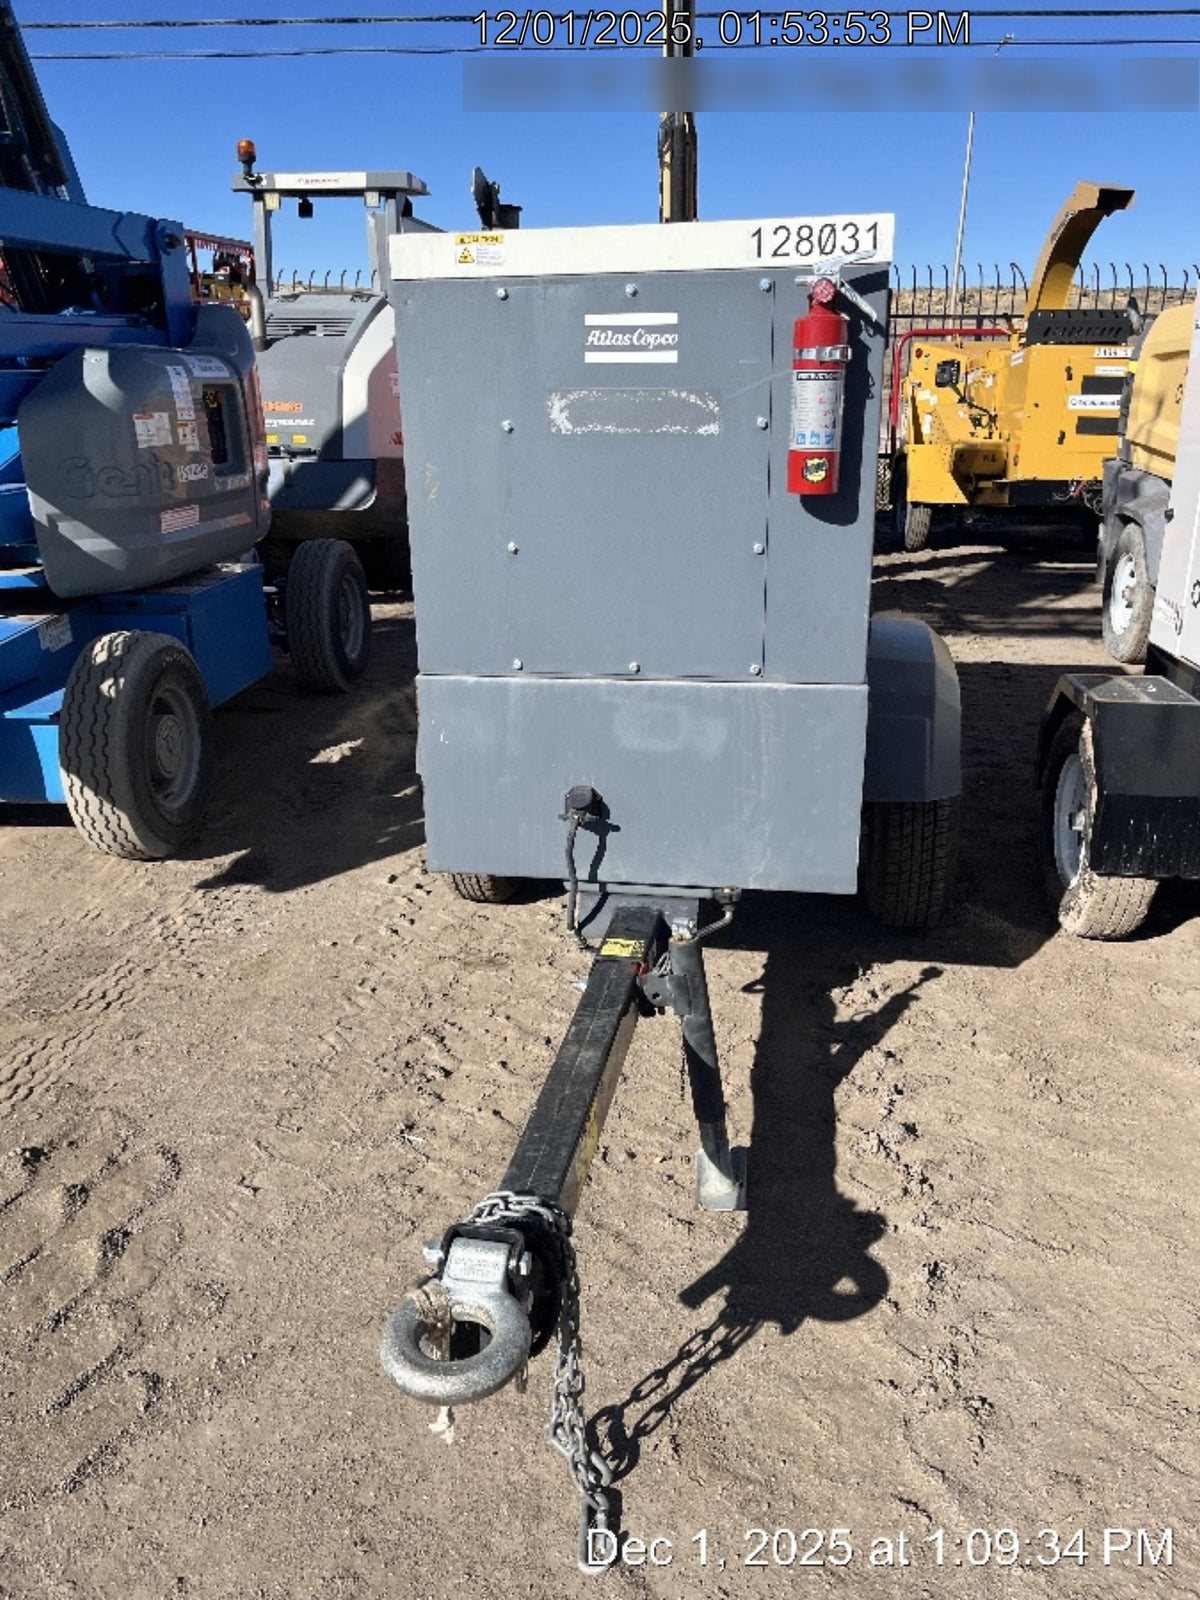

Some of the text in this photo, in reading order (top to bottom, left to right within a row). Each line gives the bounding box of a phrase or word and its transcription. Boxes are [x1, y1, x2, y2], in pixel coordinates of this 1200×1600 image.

[751, 221, 878, 258] 128031
[585, 328, 678, 349] Atlas Copco
